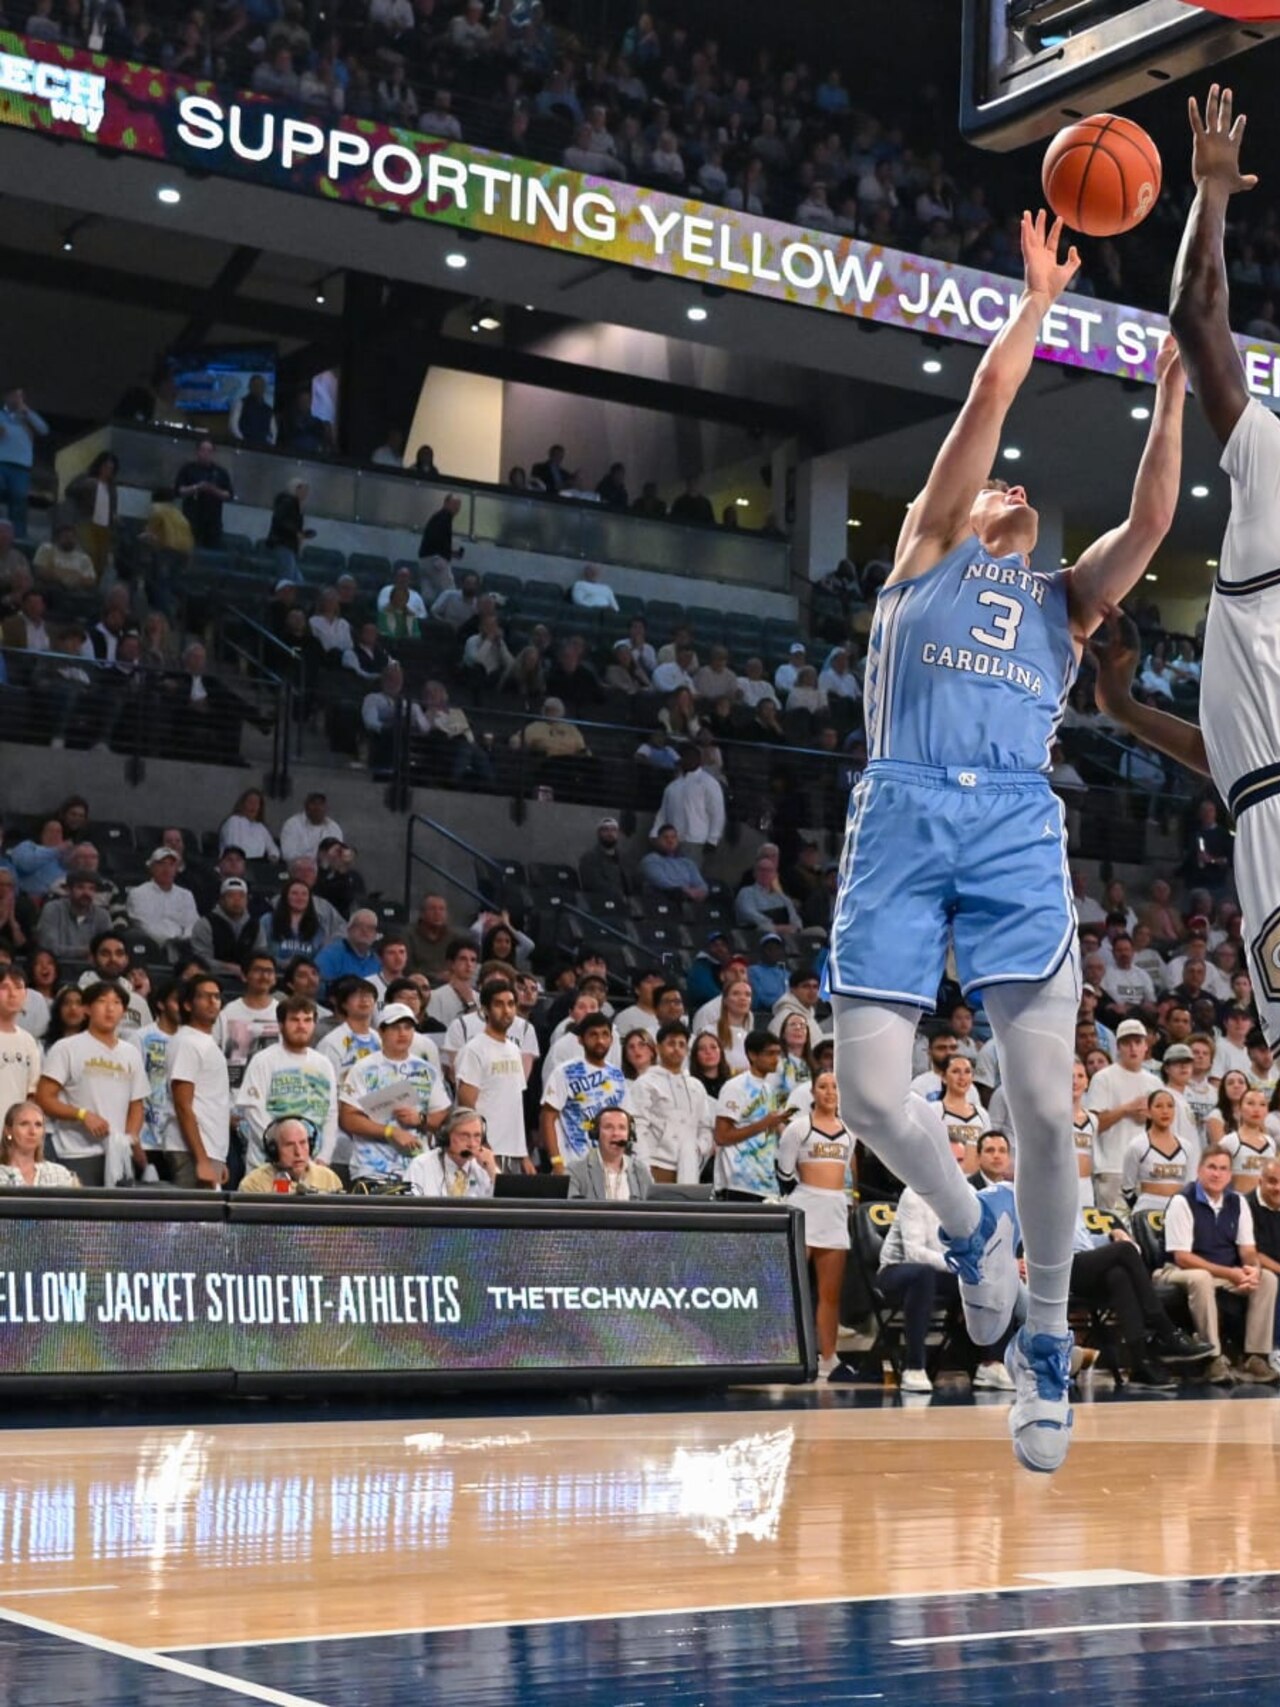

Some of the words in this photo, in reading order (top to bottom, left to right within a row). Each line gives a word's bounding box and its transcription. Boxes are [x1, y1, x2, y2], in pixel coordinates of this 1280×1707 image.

[177, 96, 616, 241] SUPPORTING
[640, 205, 883, 303] YELLOW
[964, 563, 1046, 607] NORTH
[969, 590, 1025, 651] 3
[922, 642, 1042, 697] CAROLINA
[97, 1272, 197, 1323] JACKET
[205, 1273, 462, 1324] STUDENT-ATHLETES
[486, 1286, 759, 1310] THETECHWAY.COM
